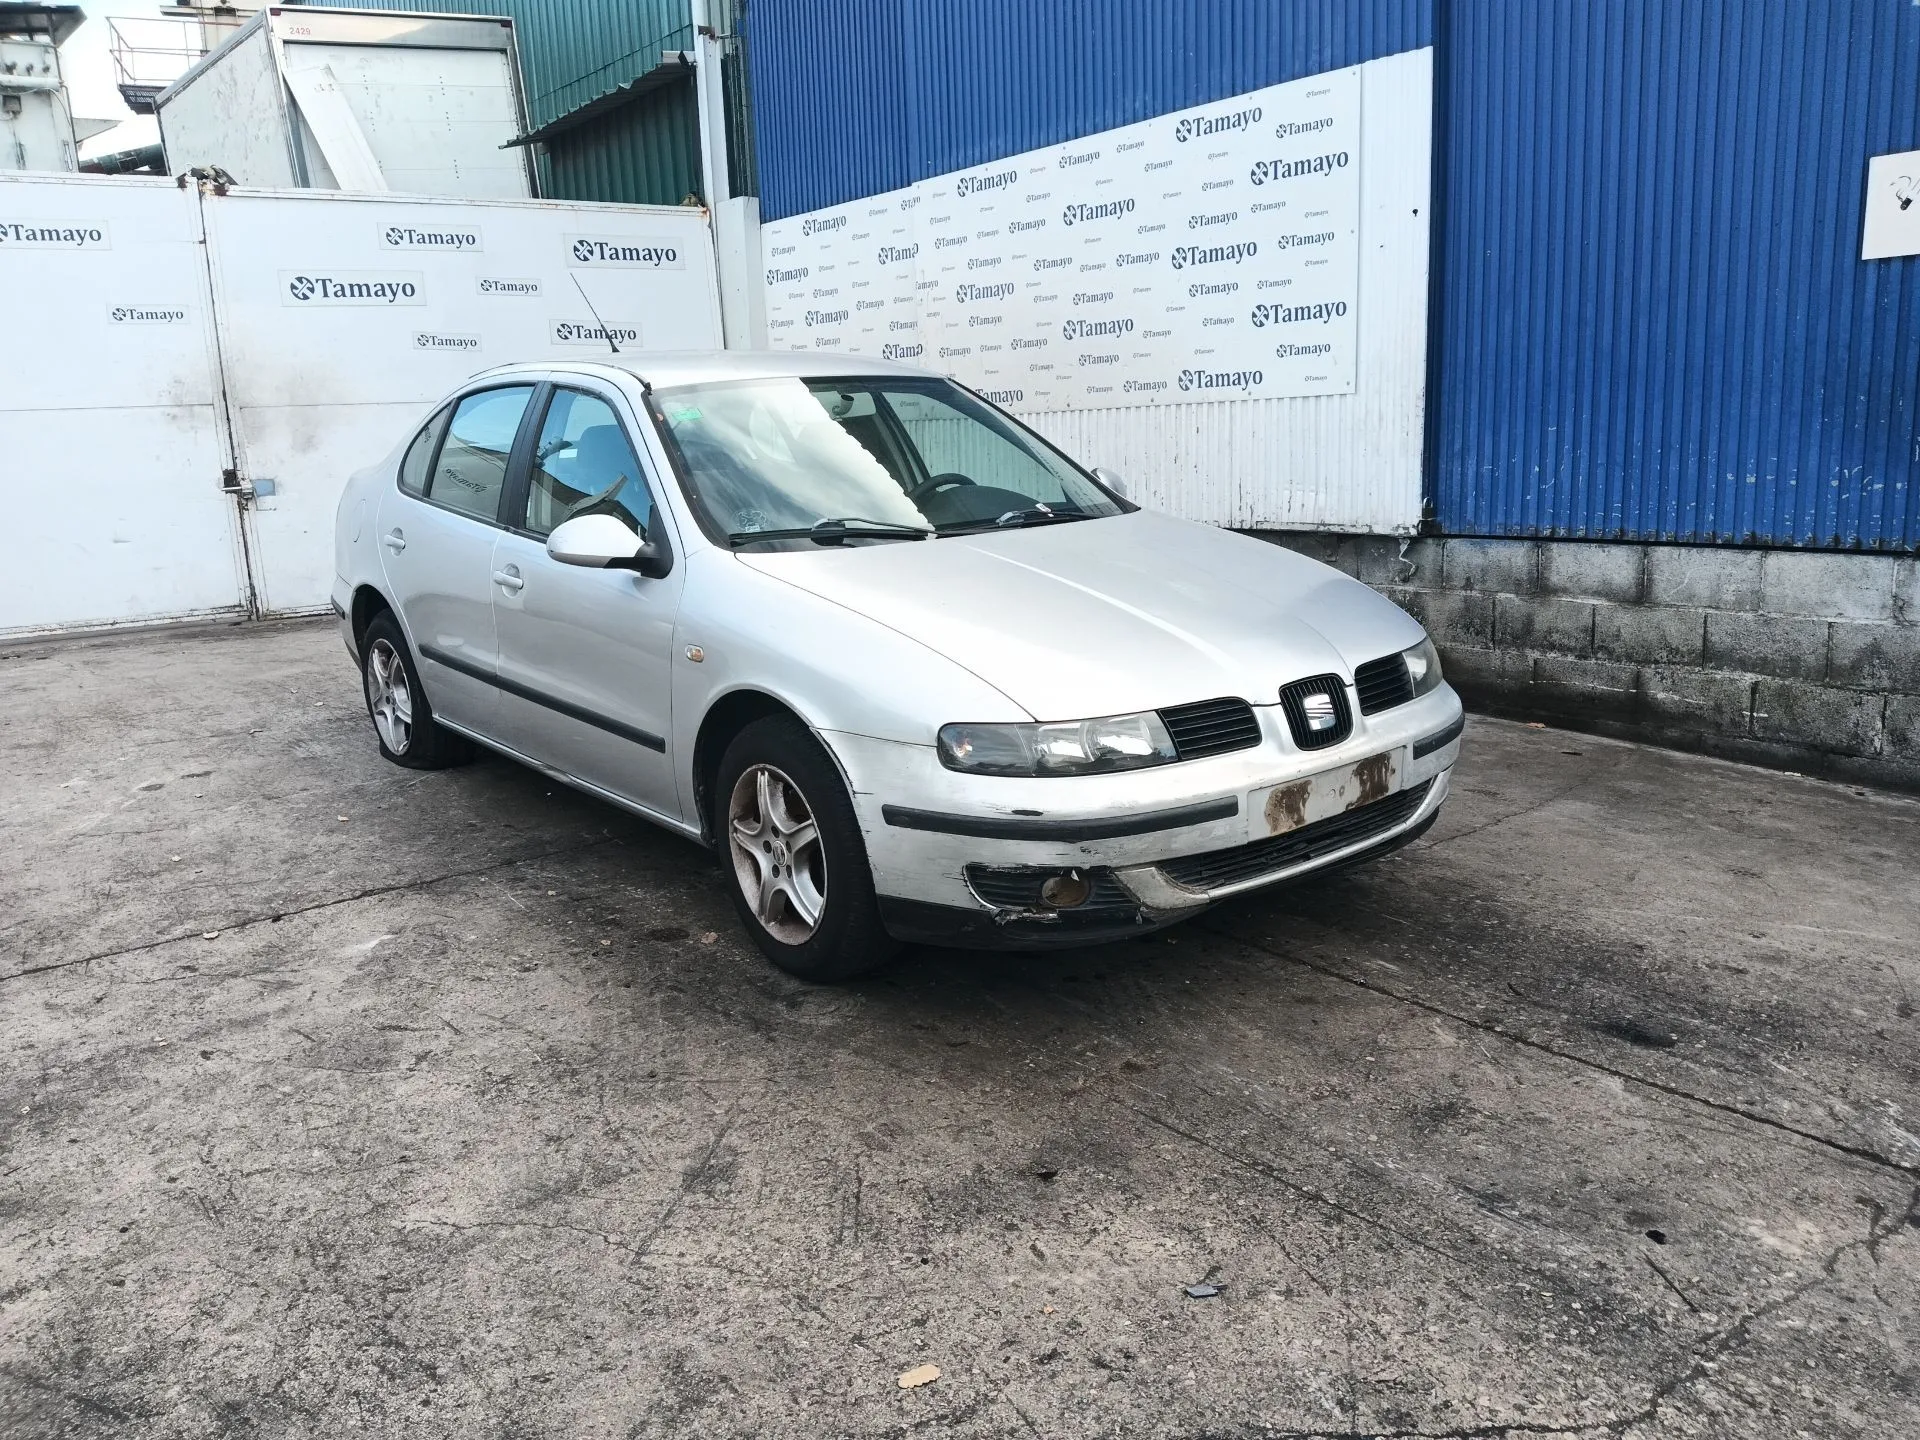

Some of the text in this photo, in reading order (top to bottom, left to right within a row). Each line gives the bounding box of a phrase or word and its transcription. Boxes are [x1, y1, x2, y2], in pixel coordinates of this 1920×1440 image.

[1193, 106, 1262, 137] Tamayo
[1287, 117, 1333, 136] Tamayo
[1122, 140, 1145, 151] Tamayo
[1067, 151, 1100, 167] Tamayo
[1150, 160, 1173, 171] Tamayo
[1270, 151, 1349, 181] Tamayo
[969, 170, 1017, 194] Tamayo
[1208, 179, 1233, 190] Tamayo
[1077, 198, 1135, 222] Tamayo
[1258, 201, 1286, 212] Tamayo
[811, 216, 847, 233] Tamayo
[1016, 218, 1046, 232] Tamayo
[1198, 211, 1238, 227] Tamayo
[8, 224, 102, 246] Tamayo
[1143, 224, 1165, 233] Tamayo
[404, 228, 477, 248] Tamayo
[941, 235, 968, 248] Tamayo
[1289, 231, 1335, 247] Tamayo
[594, 242, 677, 266] Tamayo
[1125, 252, 1160, 265] Tamayo
[1188, 241, 1257, 266] Tamayo
[974, 256, 1001, 268] Tamayo
[1041, 257, 1072, 270] Tamayo
[774, 267, 809, 283] Tamayo
[314, 277, 416, 303] Tamayo
[492, 280, 539, 295] Tamayo
[1198, 282, 1239, 295] Tamayo
[1264, 279, 1292, 289] Tamayo
[968, 282, 1014, 301] Tamayo
[1081, 291, 1114, 304] Tamayo
[862, 299, 884, 310] Tamayo
[126, 309, 184, 322] Tamayo
[813, 308, 849, 326] Tamayo
[1270, 300, 1347, 324] Tamayo
[975, 315, 1002, 326] Tamayo
[573, 325, 637, 343] Tamayo
[1077, 318, 1134, 338] Tamayo
[1149, 329, 1172, 338] Tamayo
[429, 335, 478, 349] Tamayo
[1018, 338, 1048, 350] Tamayo
[945, 347, 971, 357] Tamayo
[1287, 343, 1331, 357] Tamayo
[1086, 353, 1119, 366] Tamayo
[1131, 380, 1167, 392] Tamayo
[1193, 370, 1263, 391] Tamayo
